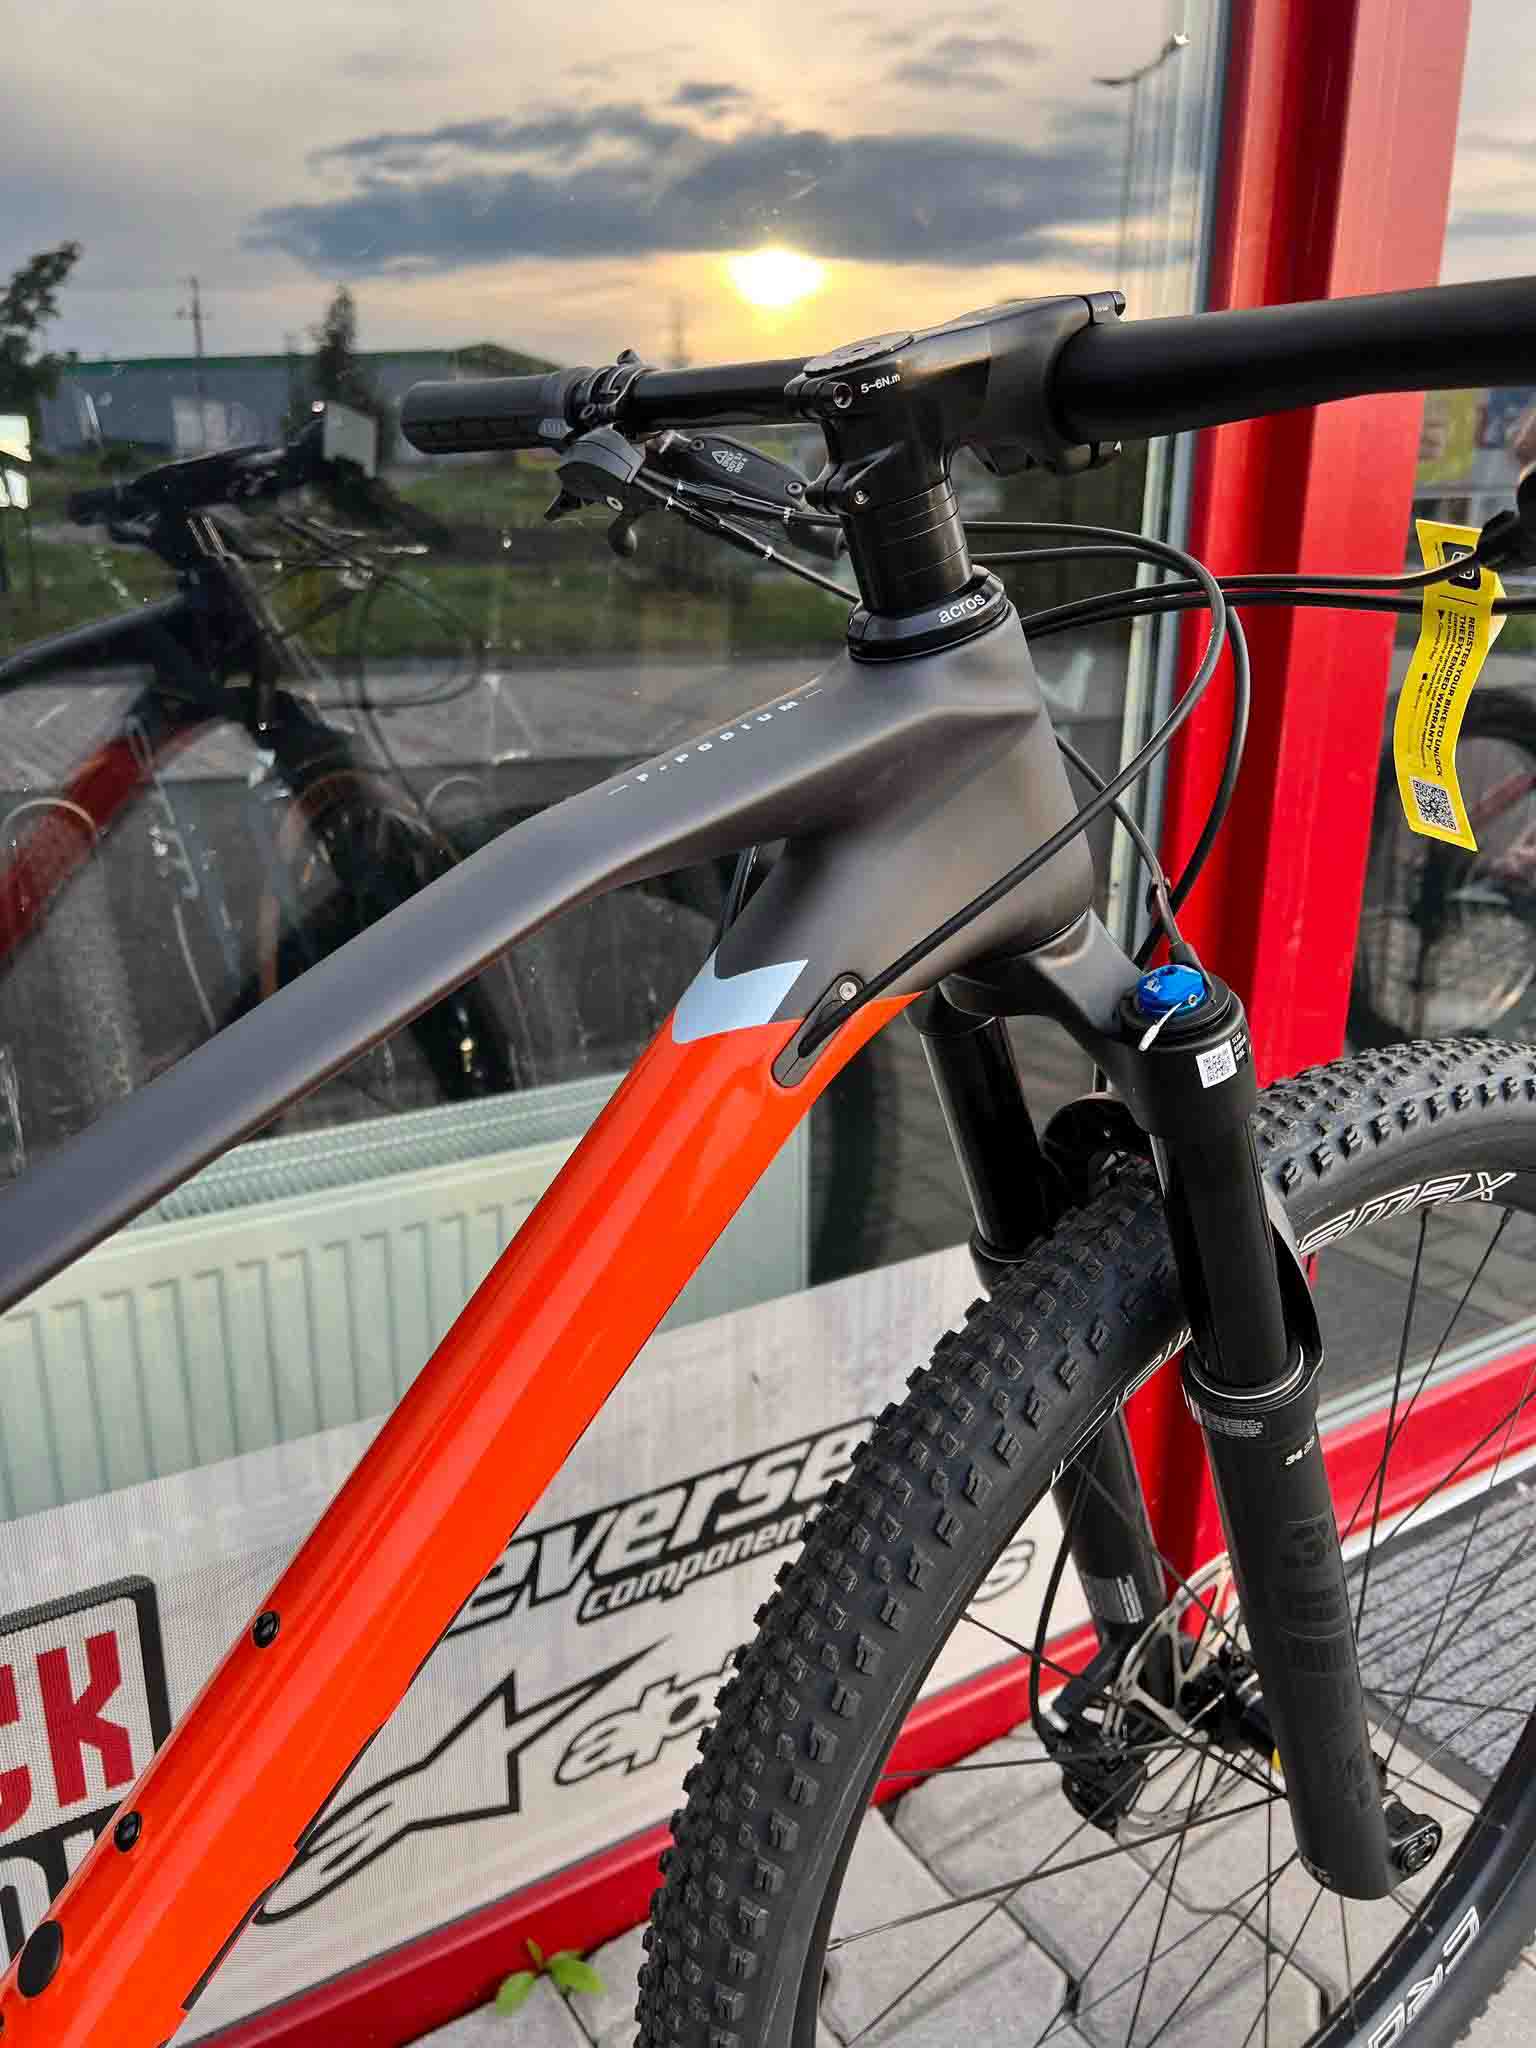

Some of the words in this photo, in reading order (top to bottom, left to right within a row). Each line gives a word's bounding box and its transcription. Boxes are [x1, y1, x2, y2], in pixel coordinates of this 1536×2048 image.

[938, 592, 987, 625] acros
[1459, 615, 1467, 634] THE
[1441, 637, 1465, 690] EXTENDED
[1459, 616, 1476, 667] REGISTER
[1447, 669, 1463, 696] YOUR
[1426, 693, 1444, 751] WARRANTY
[1437, 725, 1445, 738] TO
[1440, 699, 1451, 722] BIKE
[1433, 739, 1443, 776] UNLOCK
[450, 1418, 878, 1632] everse
[584, 1504, 821, 1617] componen
[1366, 1904, 1481, 2048] CRO
